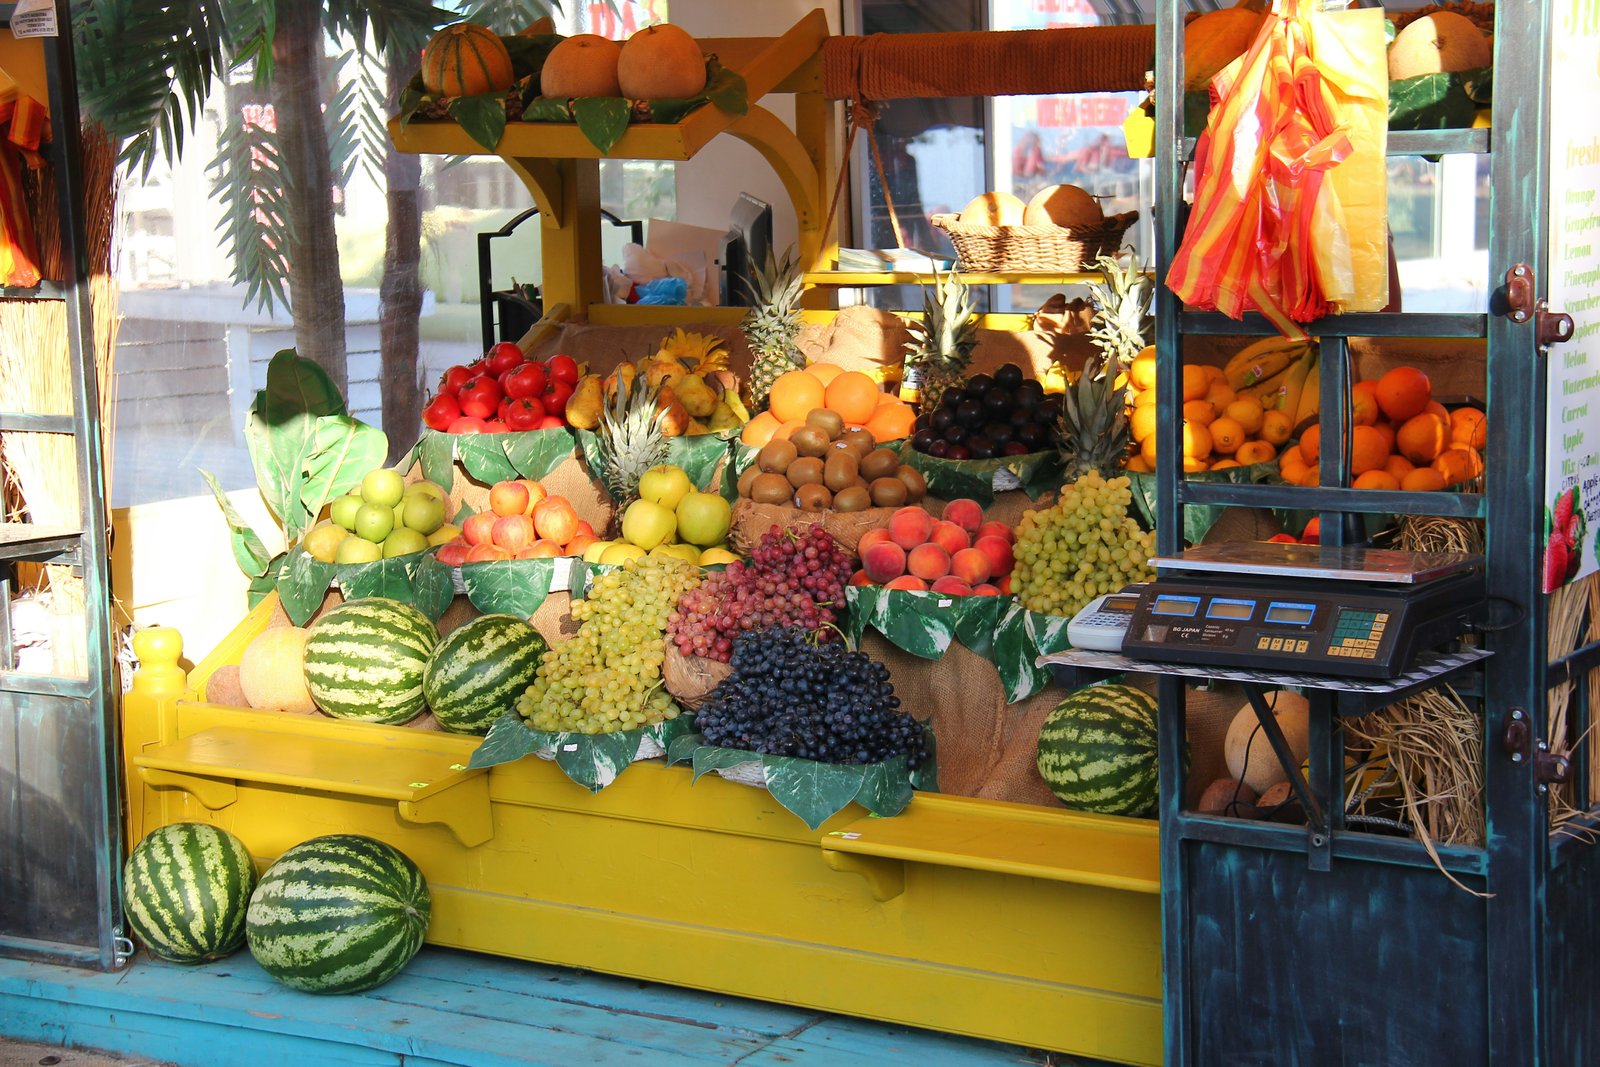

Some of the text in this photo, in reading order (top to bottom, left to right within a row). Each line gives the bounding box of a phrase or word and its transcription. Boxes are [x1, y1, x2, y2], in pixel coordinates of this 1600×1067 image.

[1565, 243, 1591, 260] Lemon
[1563, 350, 1587, 369] Melon
[1562, 404, 1588, 423] Carrot
[1562, 429, 1585, 453] Apple
